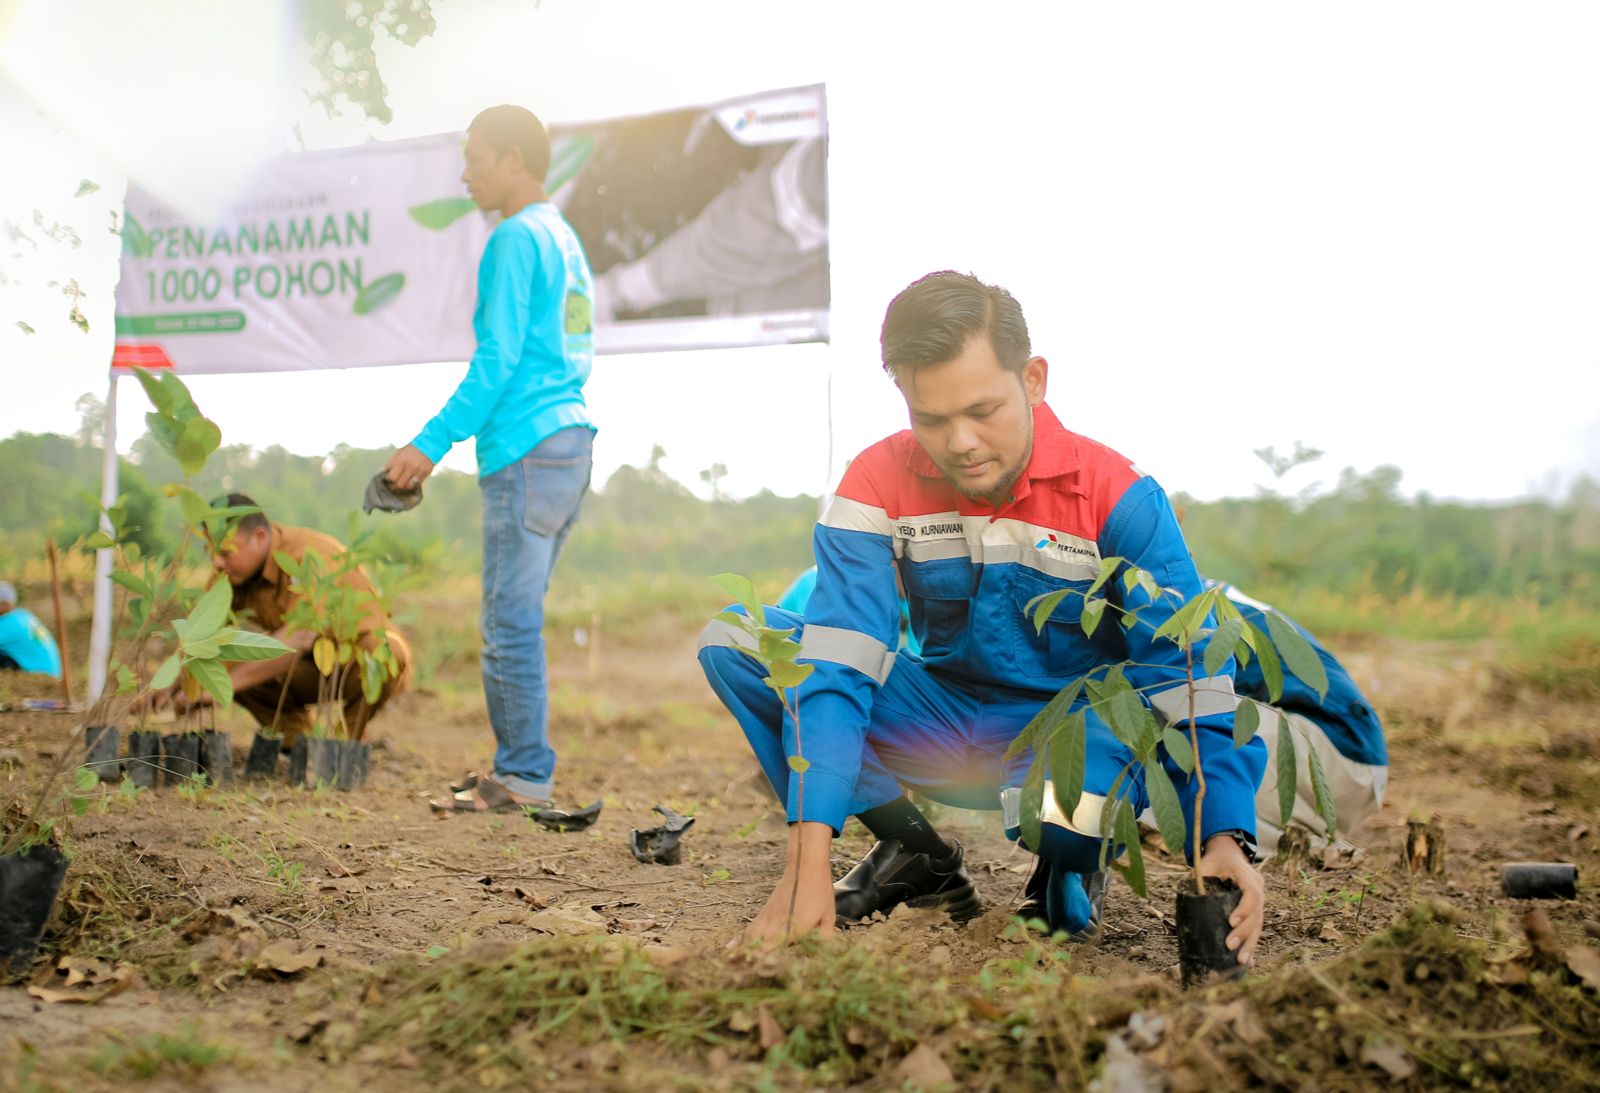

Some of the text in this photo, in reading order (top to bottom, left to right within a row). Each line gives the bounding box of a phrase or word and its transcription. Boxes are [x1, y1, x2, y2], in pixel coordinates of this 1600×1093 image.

[146, 209, 370, 258] PENANAMAN
[147, 256, 364, 303] 1000 POHON
[921, 523, 963, 536] KURNIAWAN
[1057, 544, 1096, 558] PERTAMINA
